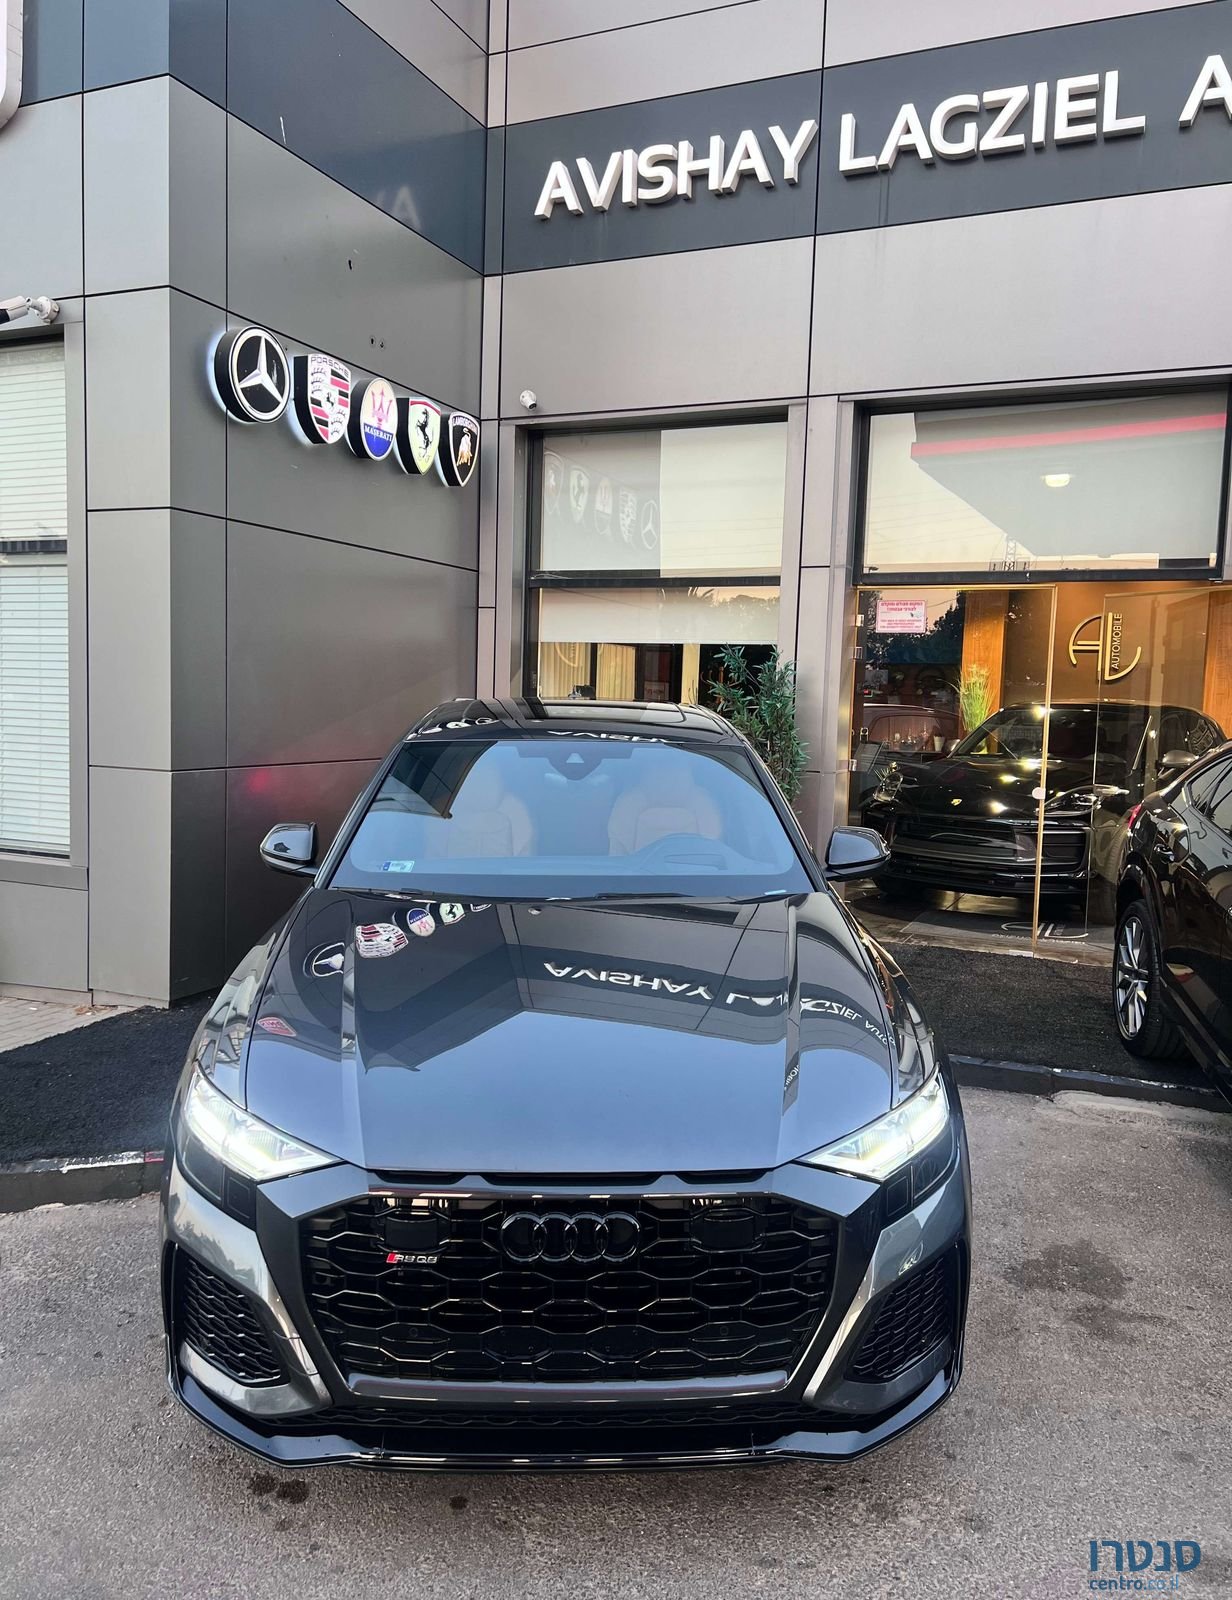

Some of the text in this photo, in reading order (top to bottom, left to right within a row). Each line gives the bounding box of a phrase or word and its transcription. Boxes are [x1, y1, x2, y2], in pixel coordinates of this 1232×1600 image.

[534, 119, 817, 219] AVISHAY
[838, 70, 1146, 176] LAGZIEL
[311, 356, 350, 378] PORSCHE
[364, 424, 392, 441] MASERATI
[1111, 613, 1123, 670] AUTOMOBILE
